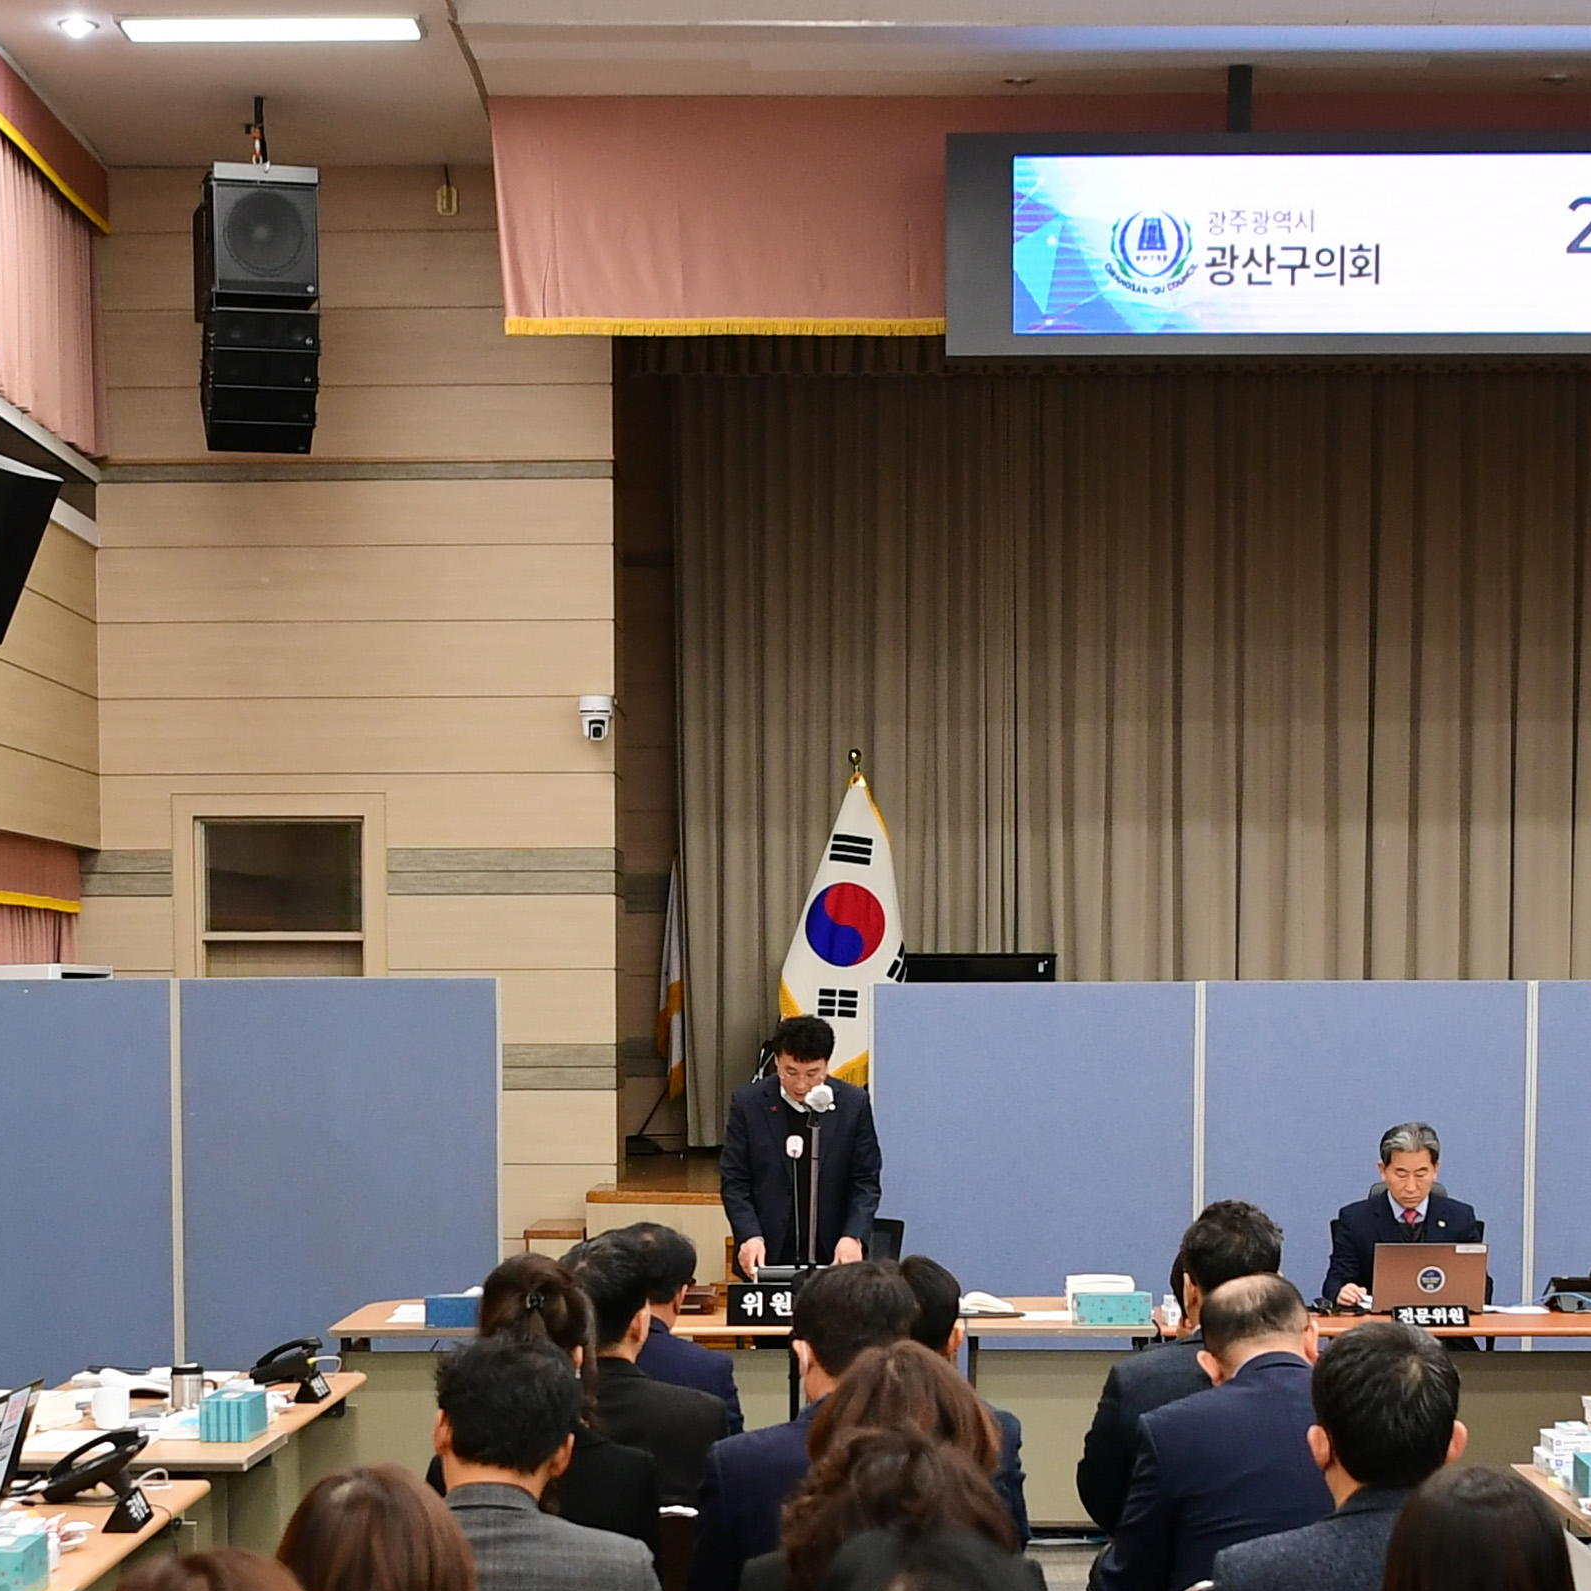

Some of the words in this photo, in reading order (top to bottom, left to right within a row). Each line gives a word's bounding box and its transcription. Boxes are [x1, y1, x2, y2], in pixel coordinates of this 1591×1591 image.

[1207, 208, 1314, 236] 광주광역시
[1205, 243, 1381, 287] 광산구의회
[1397, 1306, 1466, 1325] 전문위원
